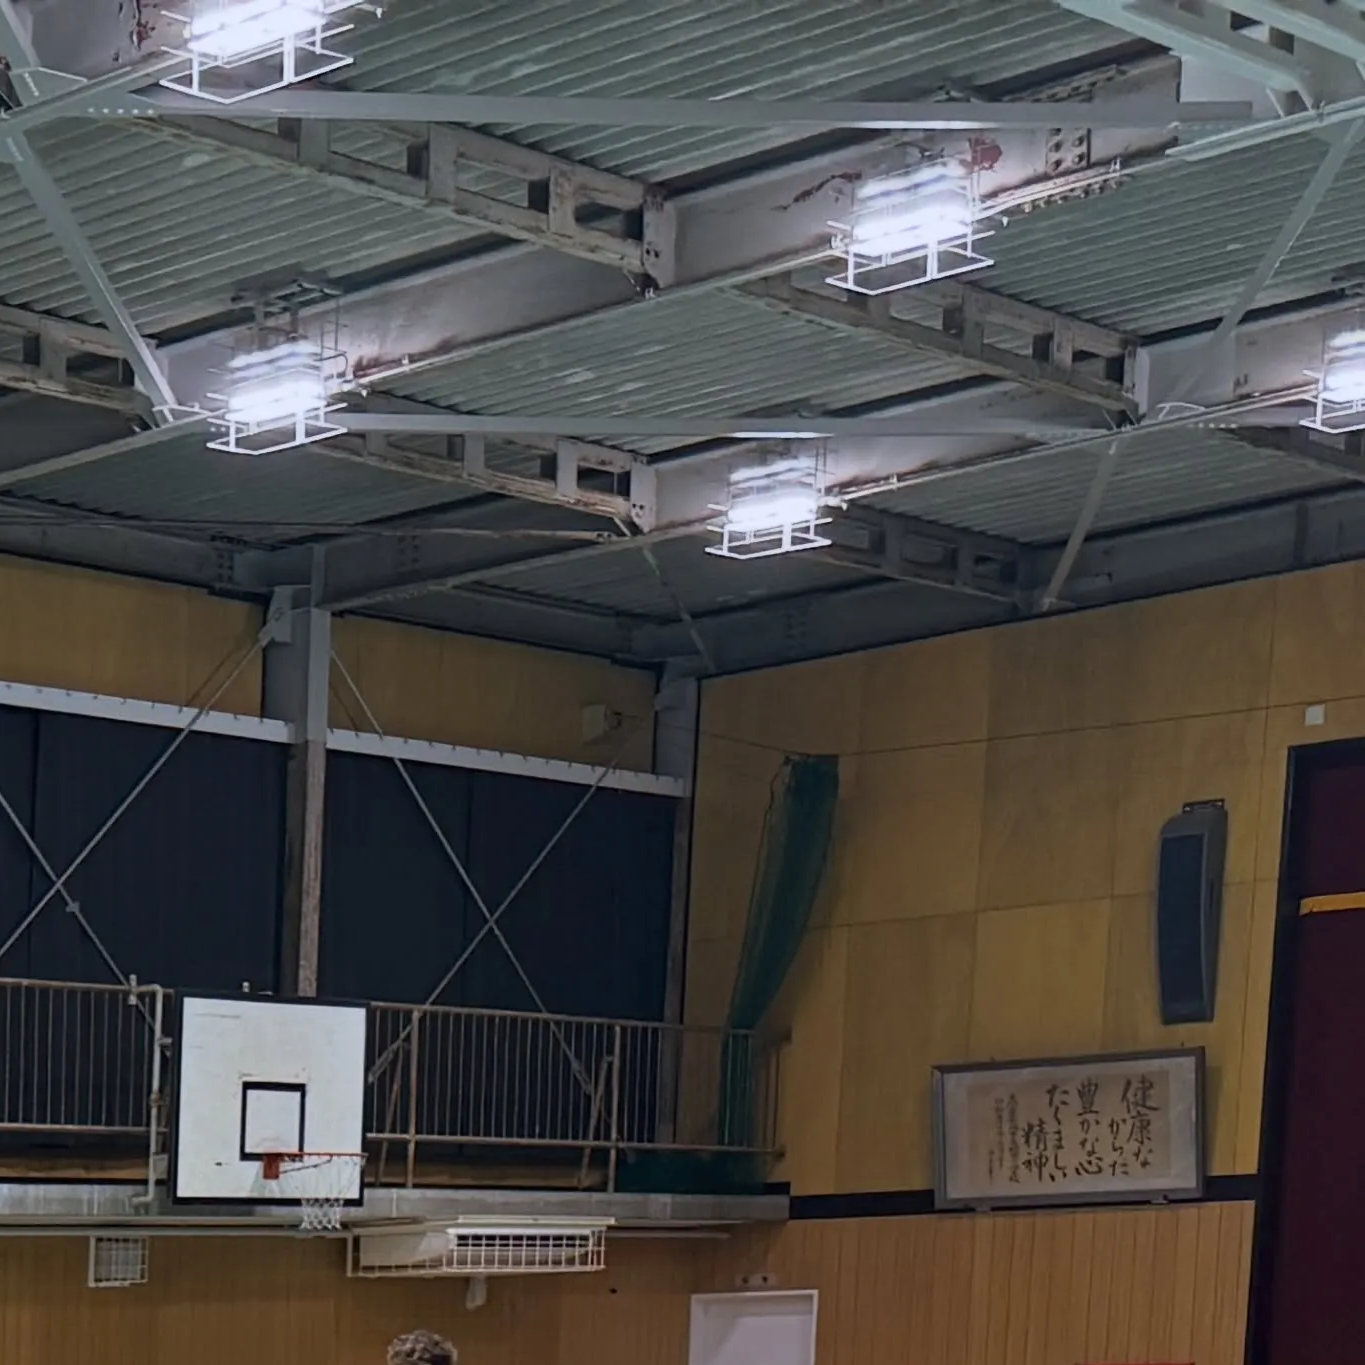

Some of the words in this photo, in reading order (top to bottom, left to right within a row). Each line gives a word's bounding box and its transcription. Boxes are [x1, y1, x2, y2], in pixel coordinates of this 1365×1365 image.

[1022, 1117, 1050, 1183] 精神
[1046, 1083, 1069, 1182] たくましい
[1075, 1077, 1103, 1177] 豊かな心
[1121, 1074, 1160, 1169] 健康な
